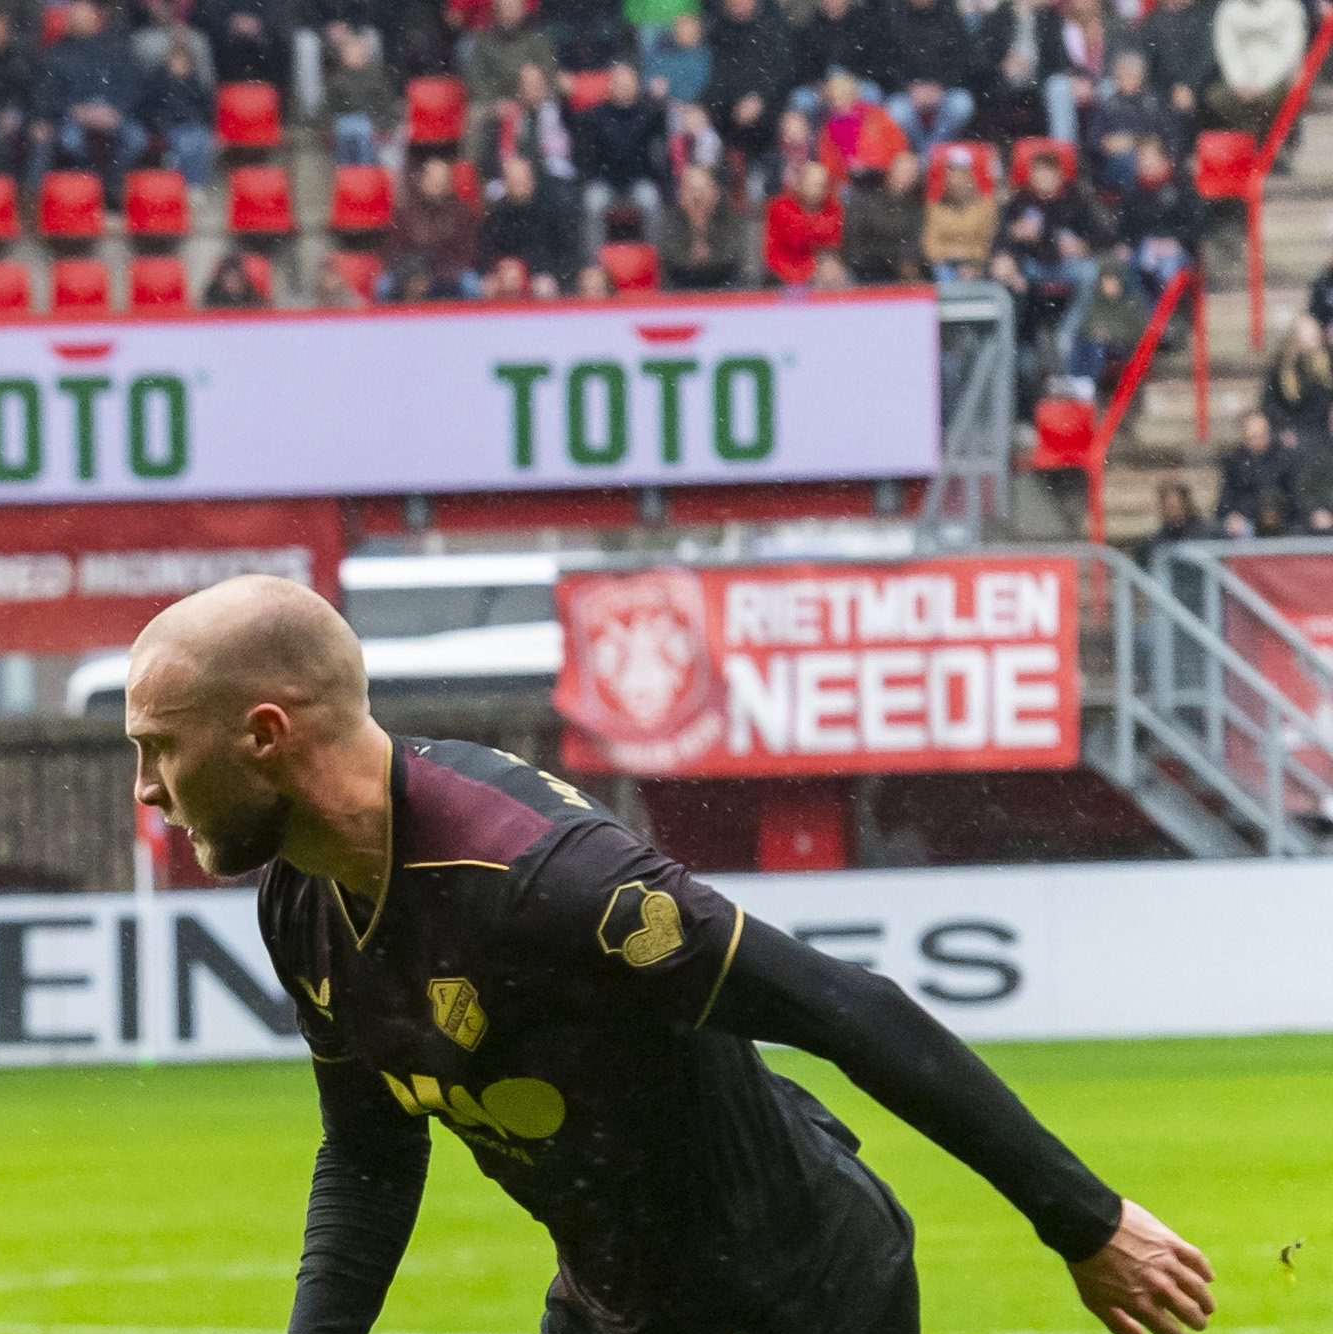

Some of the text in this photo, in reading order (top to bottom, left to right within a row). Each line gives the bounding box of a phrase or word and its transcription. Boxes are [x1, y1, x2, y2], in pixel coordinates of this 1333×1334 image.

[495, 356, 775, 469] TOTO
[722, 571, 1060, 645] RIETMOLEN
[725, 645, 1061, 756] NEEDE
